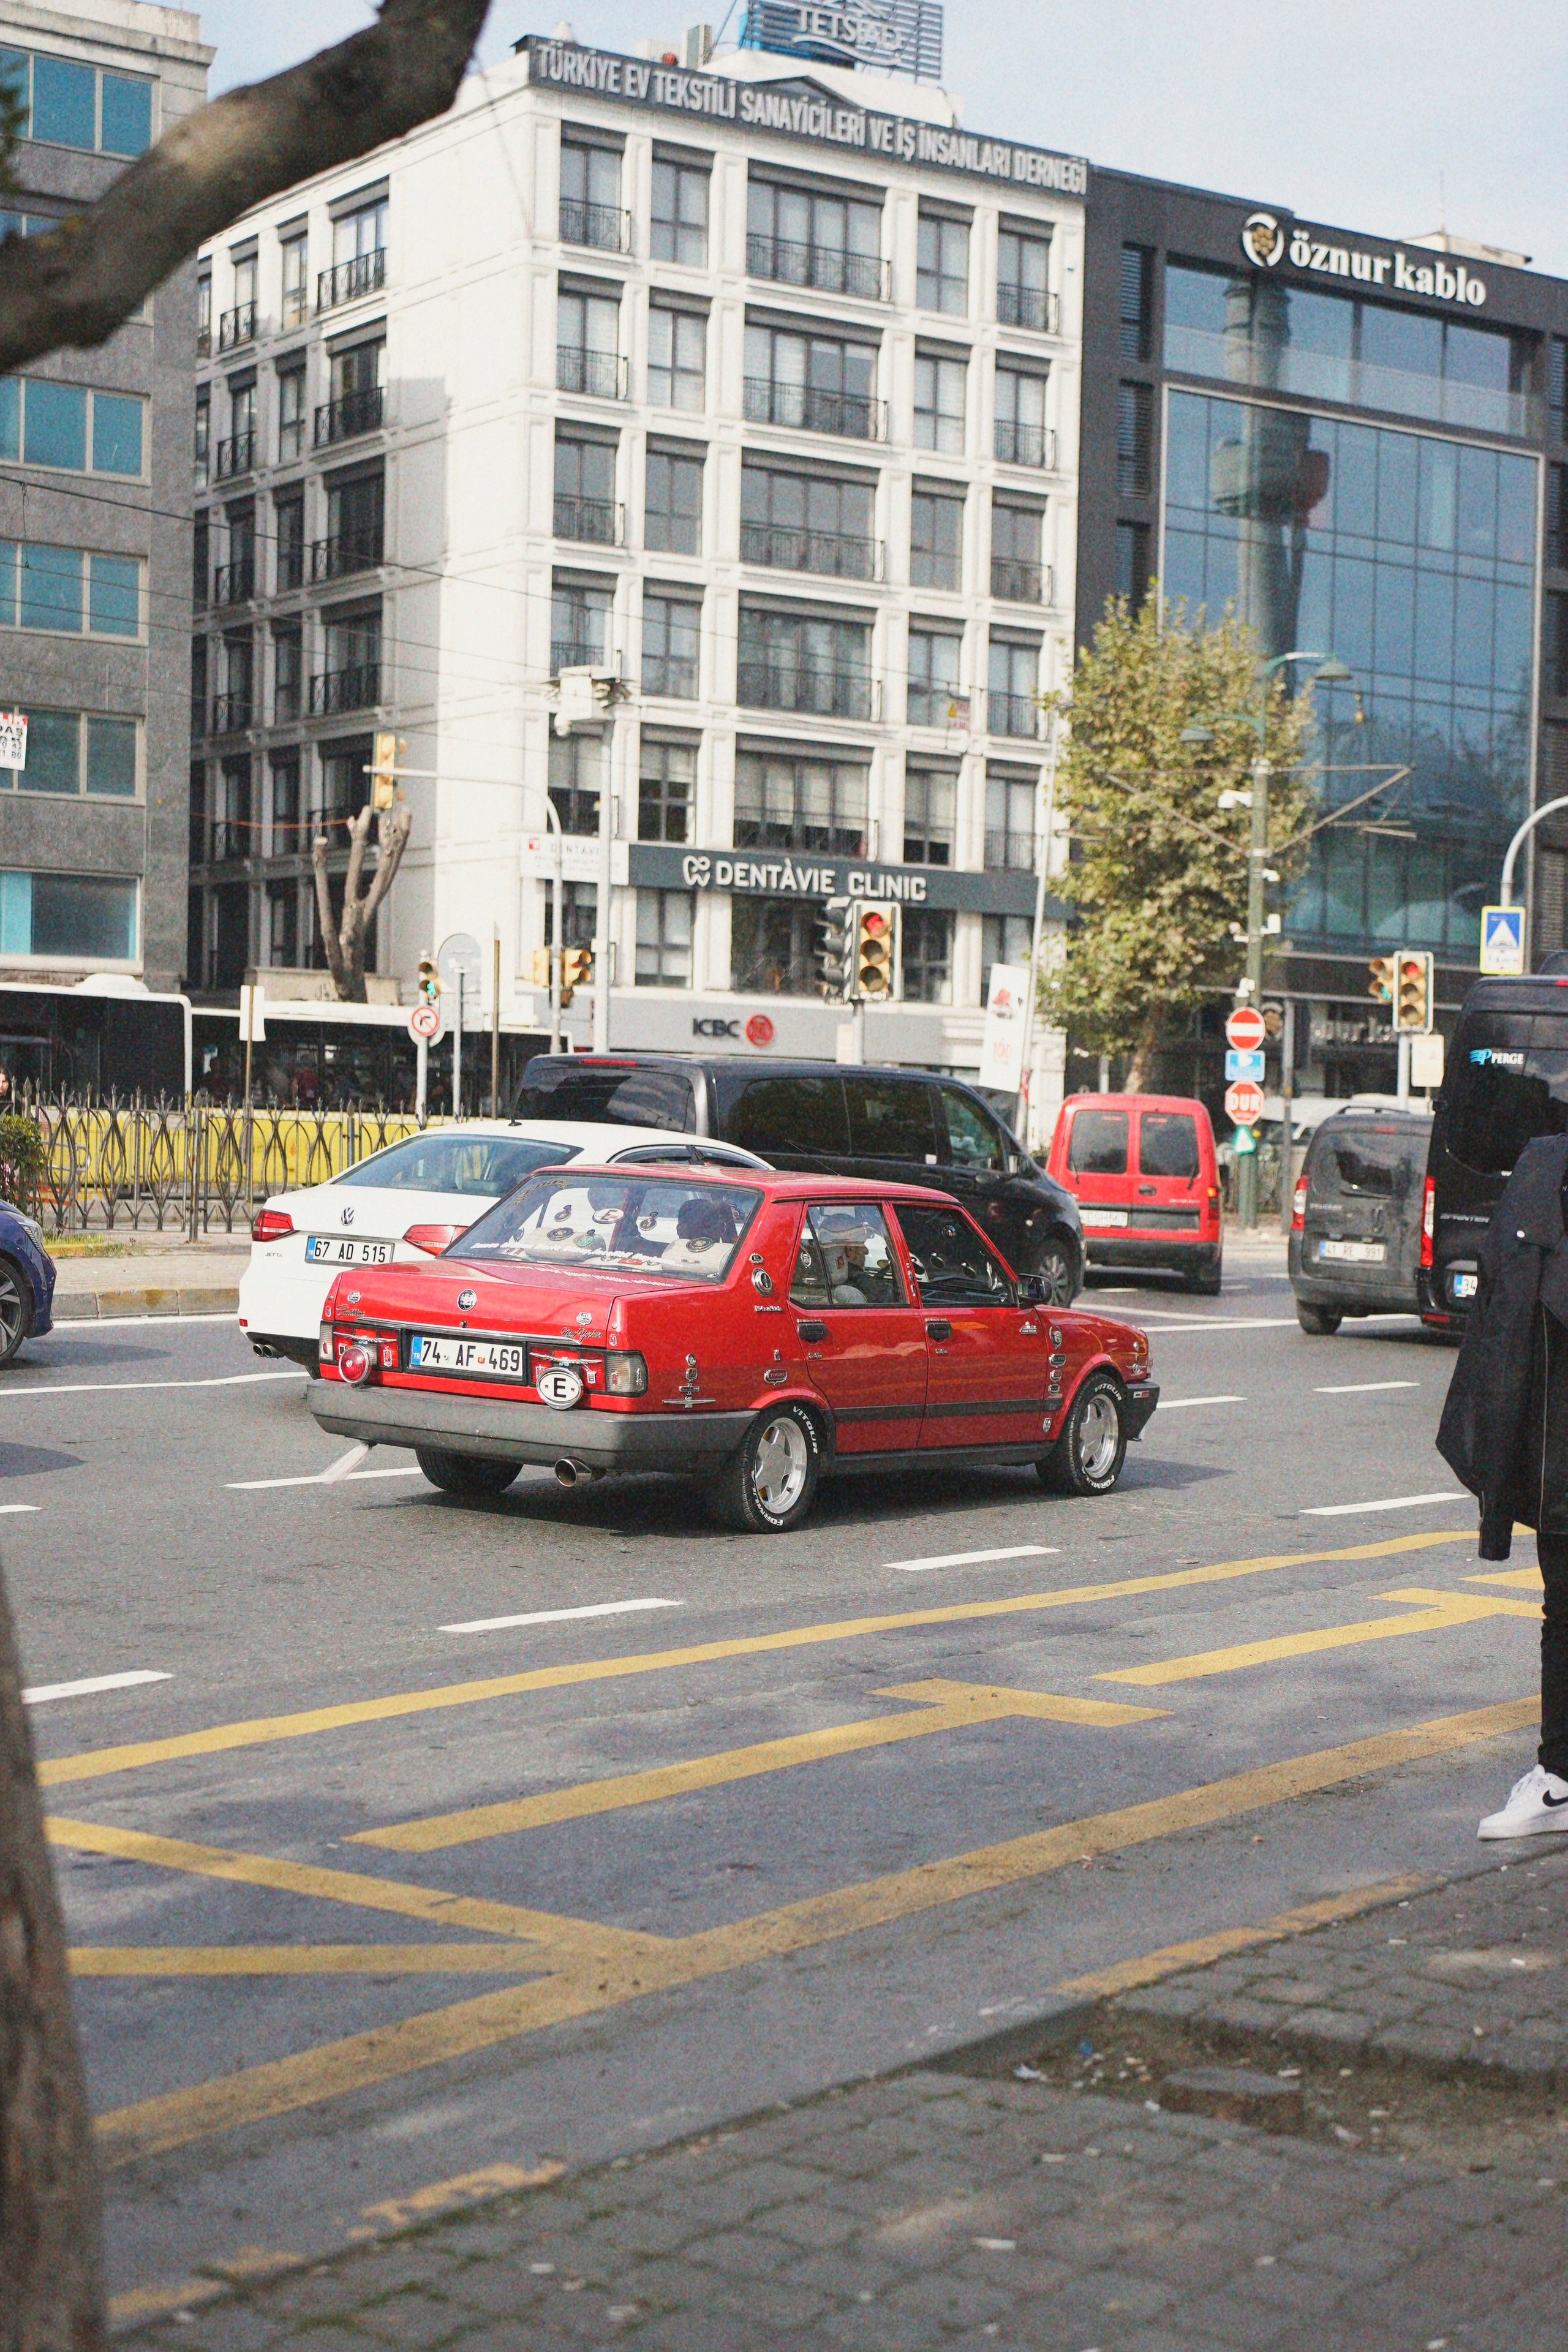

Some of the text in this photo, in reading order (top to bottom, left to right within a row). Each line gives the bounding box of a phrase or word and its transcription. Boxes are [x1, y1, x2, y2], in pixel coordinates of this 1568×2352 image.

[537, 41, 1088, 195] TÜRKİYE EV TEKSTİLİ SANAYİCİLERİ VE İŞ İNSANLARI DERNEĞİ
[1289, 228, 1487, 306] öznur kablo
[848, 870, 927, 902] CLINIC
[692, 1017, 741, 1038] ICBC
[1491, 1052, 1525, 1065] PERGE
[1230, 1092, 1261, 1112] DUR
[1439, 1213, 1490, 1224] SPRINTER
[314, 1240, 330, 1258] 67
[338, 1243, 354, 1260] AD
[362, 1245, 386, 1263] 515
[1463, 1278, 1476, 1293] 34
[560, 1327, 603, 1342] New Yorker
[421, 1340, 441, 1364] 74
[455, 1344, 477, 1367] AF
[488, 1347, 521, 1372] 469
[554, 1377, 567, 1398] E
[1095, 1382, 1123, 1401] VITOUR
[792, 1405, 819, 1455] VITOUR
